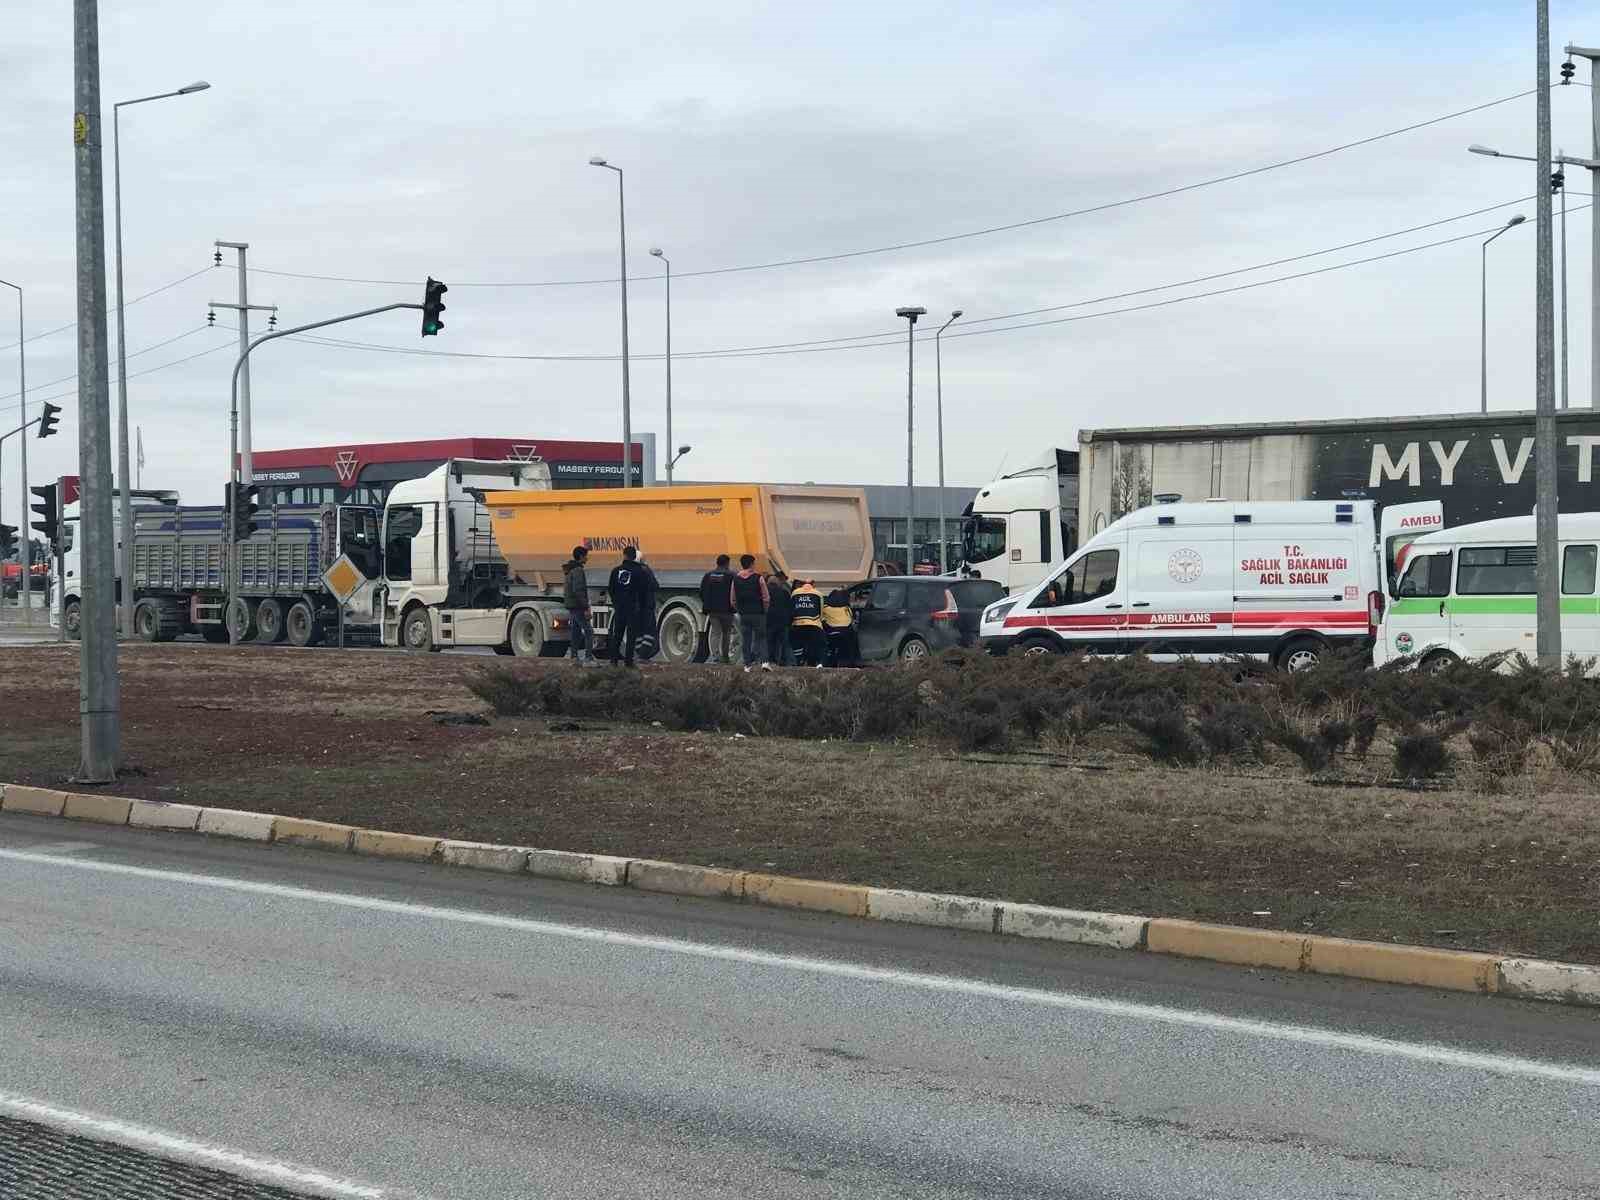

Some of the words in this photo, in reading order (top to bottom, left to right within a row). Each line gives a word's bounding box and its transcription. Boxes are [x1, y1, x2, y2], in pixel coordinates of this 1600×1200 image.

[1369, 439, 1470, 488] MY
[558, 465, 593, 473] MASSEY
[595, 466, 640, 474] FERGUN
[1400, 515, 1441, 527] AMBU
[1284, 545, 1303, 556] T.C.
[1241, 558, 1281, 571] SAĞLIK
[1287, 557, 1347, 570] BAKANLIĞI
[1150, 613, 1211, 623] AMBULANS
